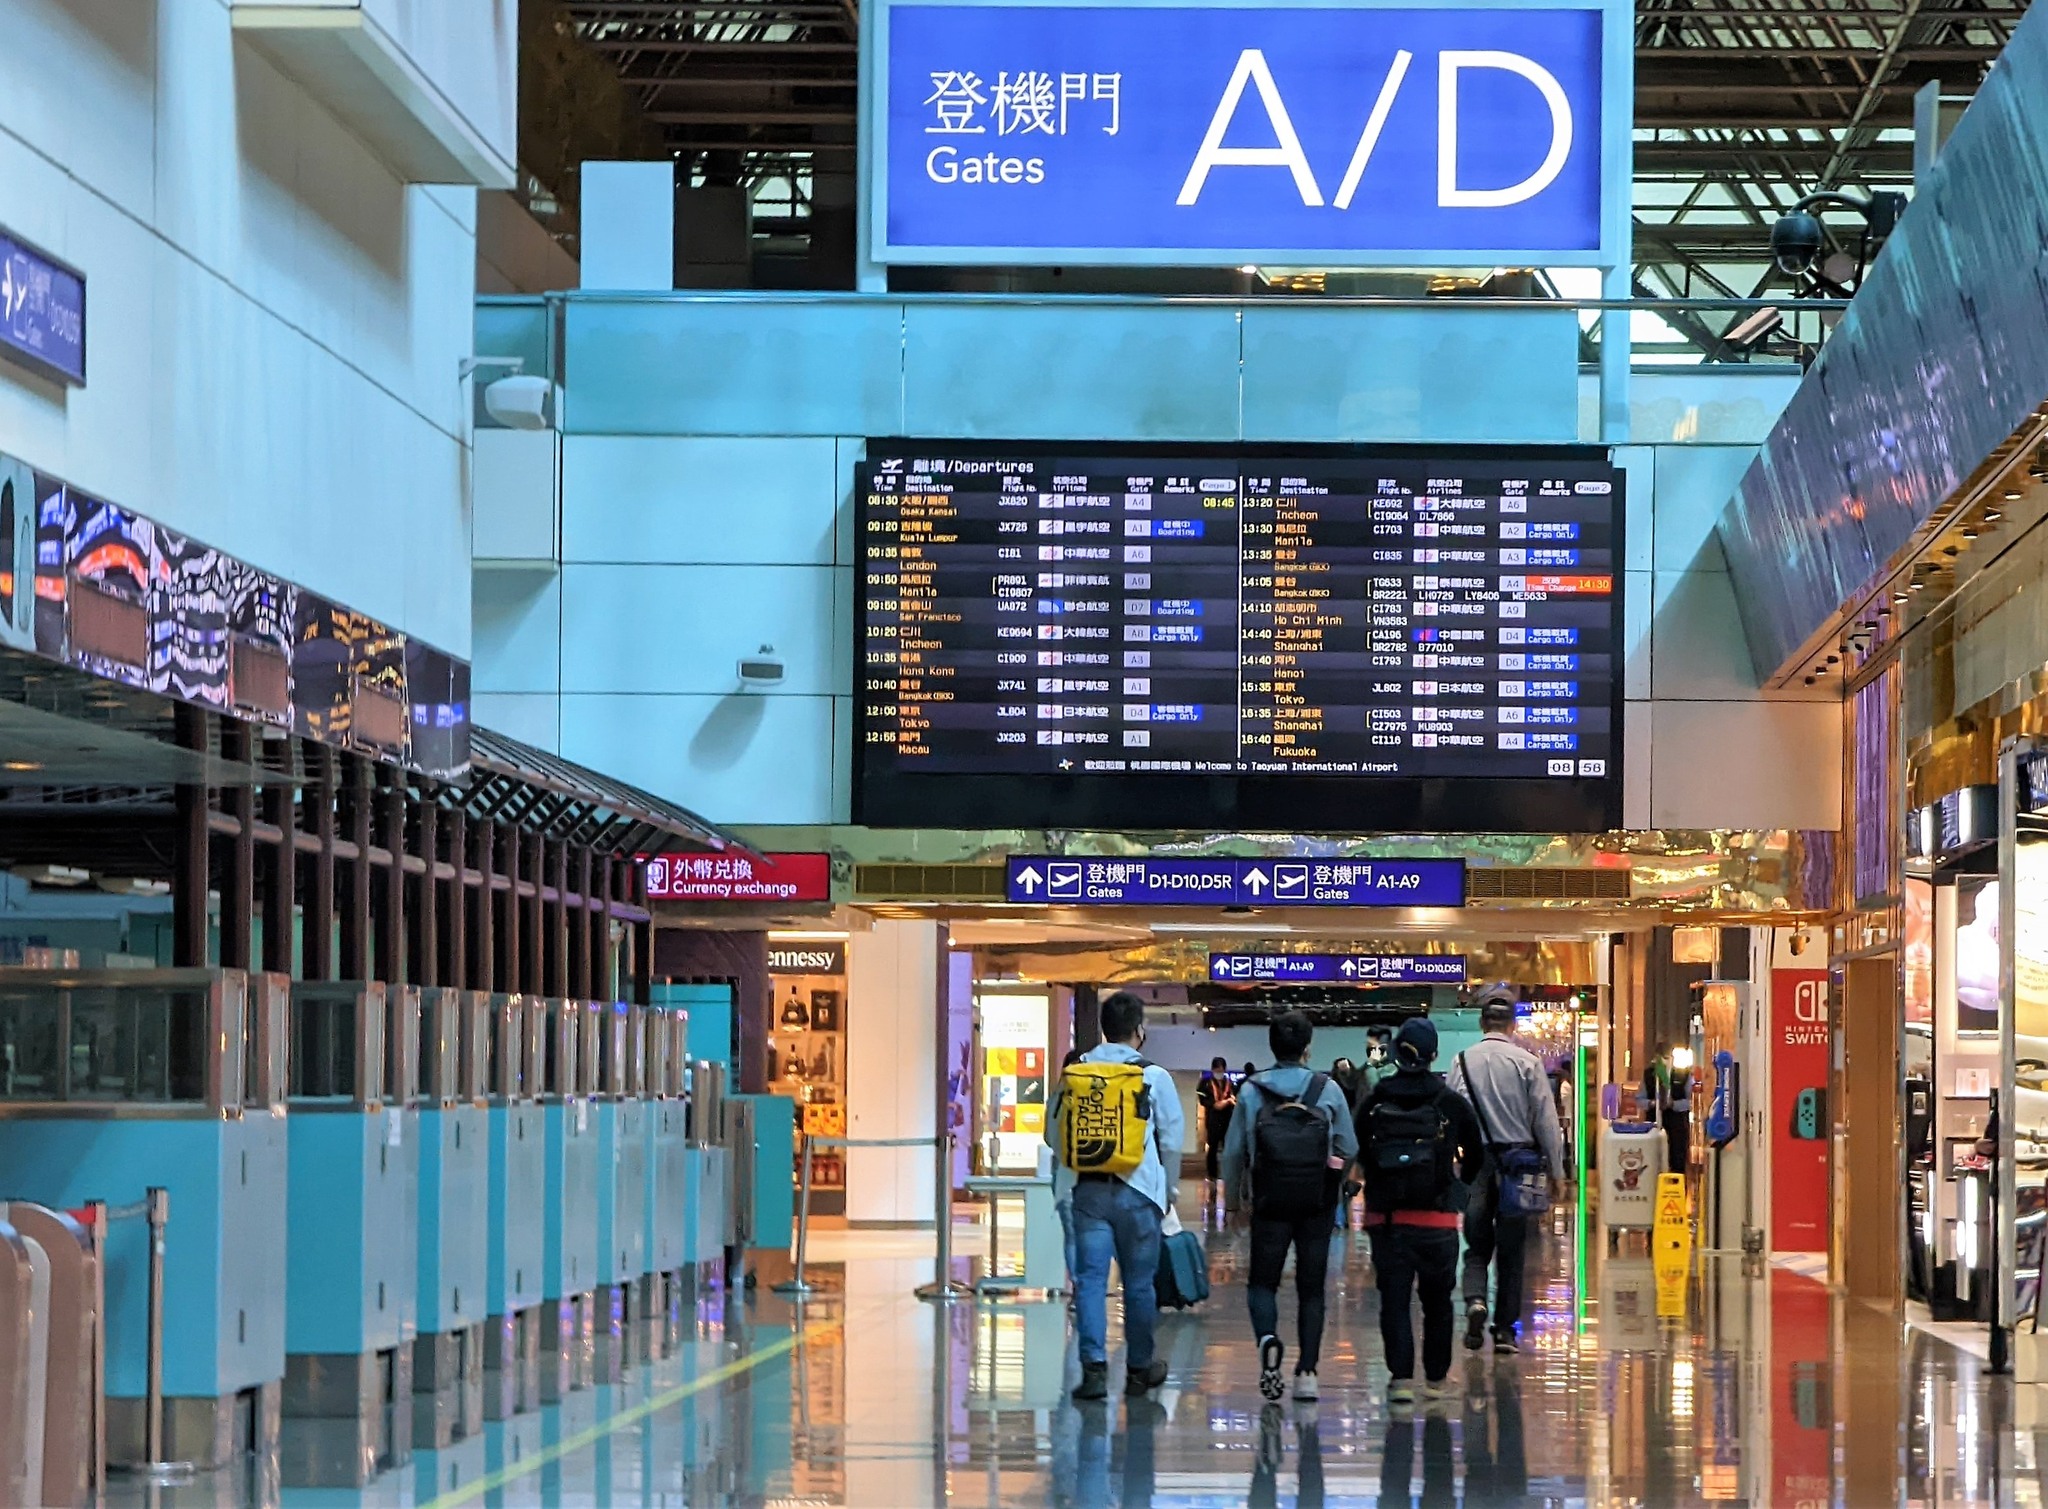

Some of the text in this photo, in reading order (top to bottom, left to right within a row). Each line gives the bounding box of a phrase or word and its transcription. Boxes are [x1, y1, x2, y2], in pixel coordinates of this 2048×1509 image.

[922, 70, 1122, 136] 登機門
[1176, 48, 1573, 209] A/D
[925, 146, 1045, 185] Gates
[1132, 498, 1145, 507] A4
[1243, 498, 1272, 508] 13:20
[1508, 500, 1520, 510] A6
[1276, 510, 1318, 520] Incheon
[1132, 524, 1144, 532] A1
[1243, 524, 1272, 534] 13:30
[1374, 525, 1402, 534] CI703
[1508, 527, 1520, 536] A2
[1275, 536, 1312, 546] Manila
[1132, 550, 1144, 559] A6
[1243, 550, 1272, 560] 13:35
[1507, 553, 1520, 562] A3
[900, 561, 937, 570] London
[1242, 578, 1272, 587] 14:05
[1506, 580, 1519, 588] A4
[1578, 580, 1608, 588] 14:30
[1373, 590, 1408, 600] BR2221
[1132, 604, 1144, 612] D7
[1242, 604, 1272, 613] 14:10
[1506, 606, 1519, 614] A9
[1274, 616, 1342, 625] Ho Chi Minh
[1242, 630, 1272, 639] 14:40
[1506, 632, 1519, 640] D4
[900, 639, 942, 649] Incheon
[1242, 655, 1272, 664] 14:40
[1506, 658, 1519, 667] D6
[1274, 669, 1305, 678] Hanoi
[997, 680, 1026, 690] JX741
[1132, 682, 1142, 691] A1
[1242, 682, 1272, 692] 15:35
[1506, 686, 1518, 694] D3
[1274, 694, 1305, 704] Tokyo
[1242, 708, 1272, 718] 16:35
[1372, 709, 1401, 718] CI503
[1506, 711, 1518, 720] A6
[1274, 721, 1323, 730] Shanghai
[997, 733, 1026, 742] JX203
[1130, 735, 1142, 744] A1
[1242, 734, 1272, 744] 16:40
[1506, 738, 1518, 746] A4
[899, 744, 930, 754] Macau
[1274, 747, 1317, 757] Fukuoka
[1196, 761, 1399, 772] Welcome to Taoyuan International Airport
[1552, 762, 1602, 772] 08 58
[1087, 864, 1146, 884] 登機門
[1313, 865, 1372, 886] 登機門
[1150, 874, 1232, 890] D1-D10,D5R
[1376, 874, 1420, 889] A1-A9
[673, 880, 798, 897] Currency exchange
[1087, 886, 1123, 898] Gates
[1314, 888, 1350, 900] Gates
[1254, 958, 1288, 970] 登機門
[1289, 962, 1314, 972] A1-A9
[1380, 958, 1414, 970] 登機門
[1254, 970, 1275, 978] Gates
[1380, 970, 1402, 978] Gates
[1077, 1096, 1090, 1136] FACE
[1090, 1084, 1104, 1138] ORTH
[1104, 1106, 1118, 1137] THE
